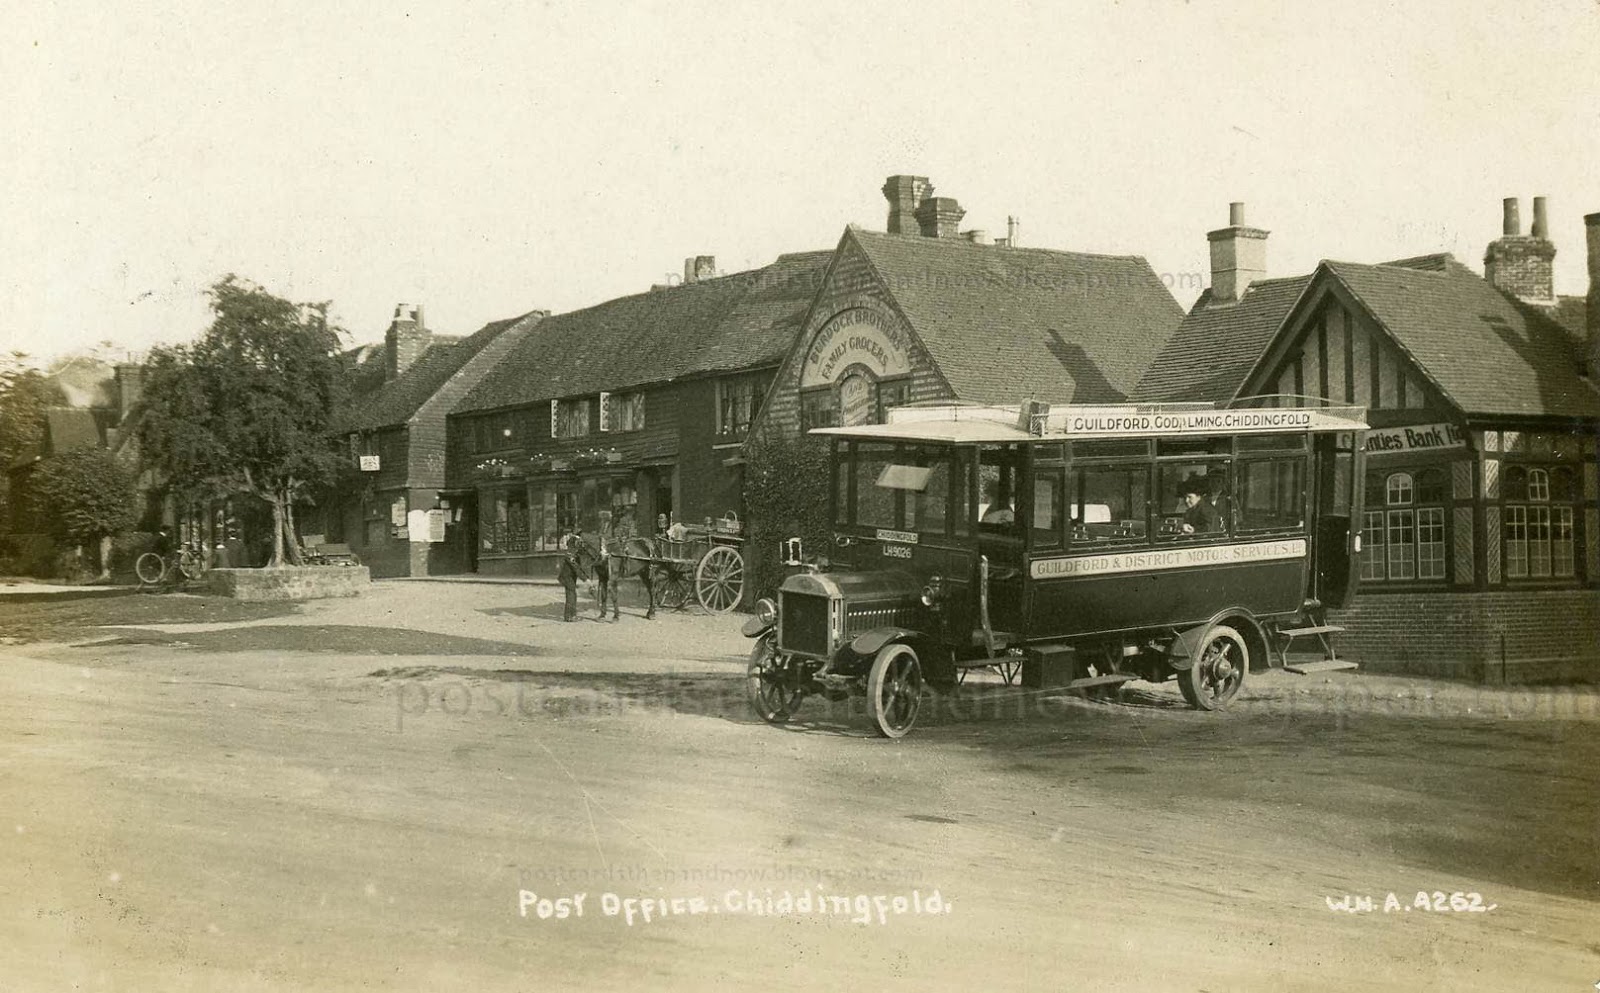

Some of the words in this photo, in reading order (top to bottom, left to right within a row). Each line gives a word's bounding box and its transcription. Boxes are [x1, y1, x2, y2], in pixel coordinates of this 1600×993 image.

[855, 310, 901, 352] BROTHERS
[821, 340, 848, 380] FAMILY
[848, 336, 889, 367] GROCERS
[1225, 413, 1310, 427] CHIDDINGFOLD
[1404, 426, 1445, 448] Bank
[883, 545, 912, 558] LH9026
[1037, 559, 1109, 575] GUILDFORD
[1112, 557, 1122, 570] &
[1124, 552, 1181, 568] DISTRICT
[1187, 548, 1229, 563] MOTOR
